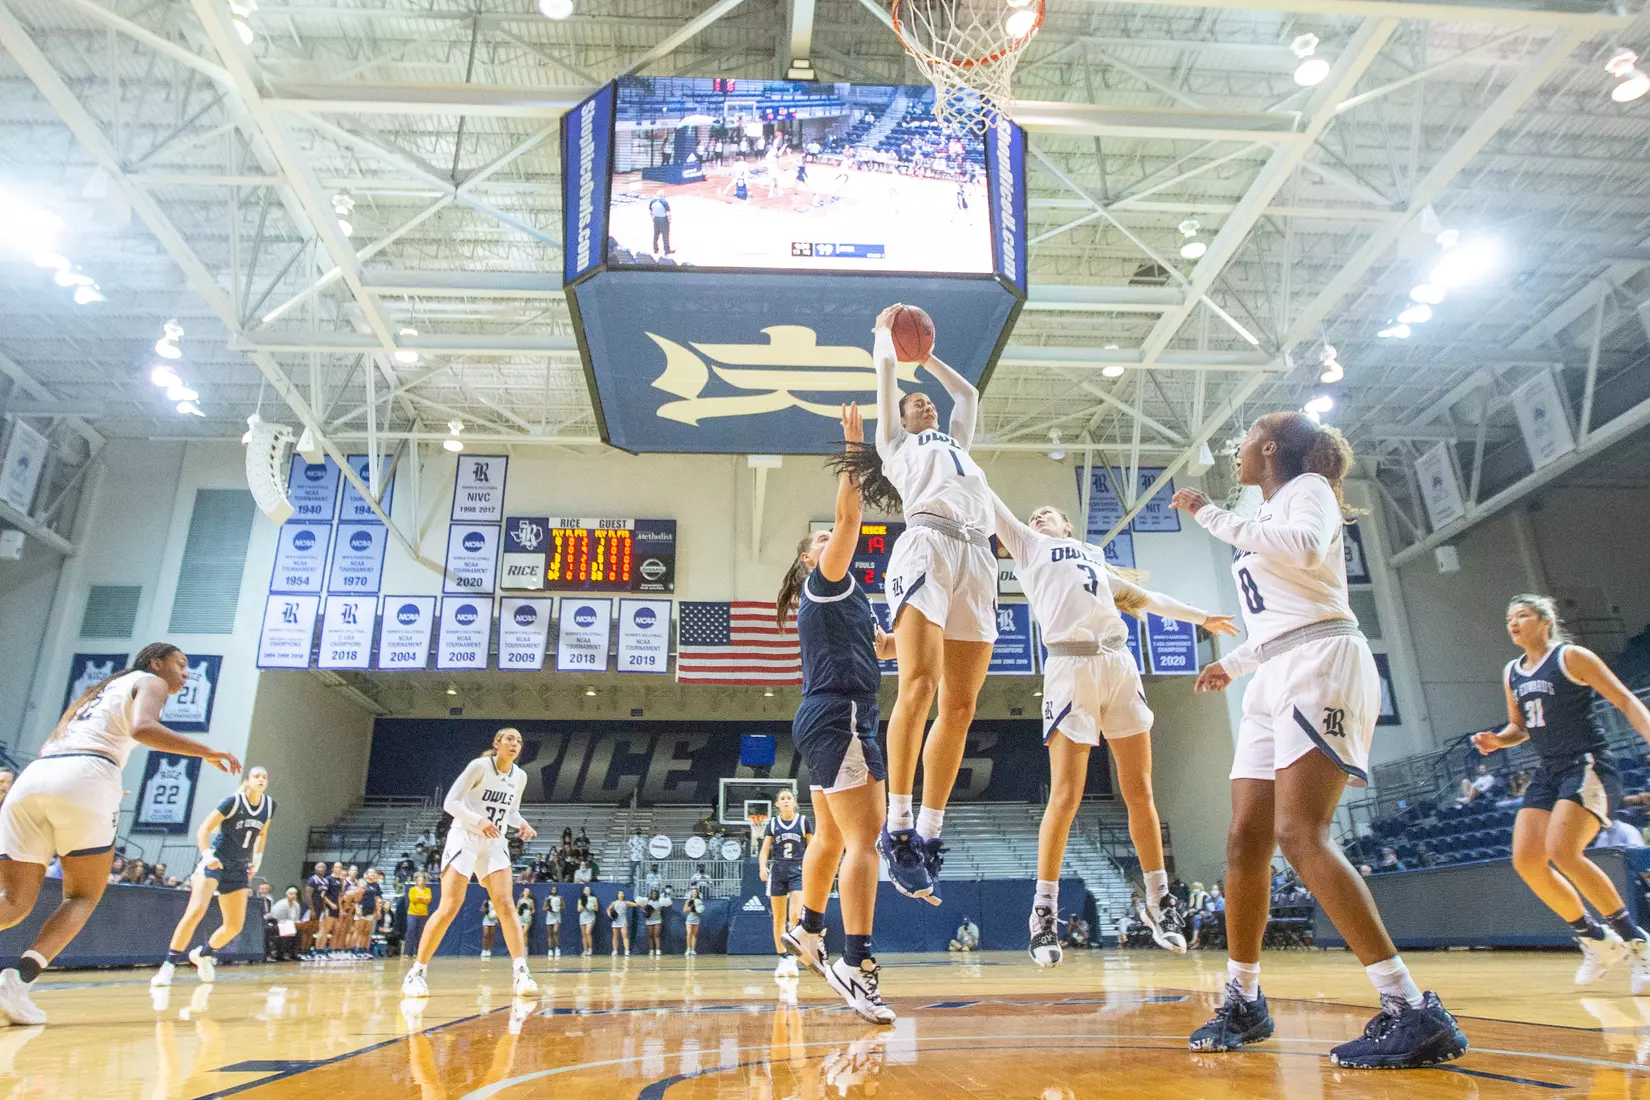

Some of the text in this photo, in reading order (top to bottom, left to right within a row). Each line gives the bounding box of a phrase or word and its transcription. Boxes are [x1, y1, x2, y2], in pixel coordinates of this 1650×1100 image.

[576, 99, 596, 273] ShopRiceOwls.com
[996, 118, 1016, 281] ShopRiceU.com
[917, 432, 961, 450] OWL
[948, 448, 966, 477] 1
[467, 492, 490, 502] NIVC
[298, 505, 322, 514] 1940
[1146, 504, 1161, 513] NIT
[560, 519, 581, 528] RICE
[599, 519, 628, 529] GUEST
[861, 525, 887, 535] RICE
[635, 532, 673, 540] Methodist
[508, 564, 540, 576] RICE
[285, 576, 310, 586] 1954
[343, 576, 368, 586] 1970
[456, 577, 483, 587] 2020
[864, 569, 875, 584] 2
[1076, 564, 1098, 597] 3
[1238, 567, 1266, 614] 0
[332, 651, 358, 661] 2018
[390, 652, 417, 661] 2004
[449, 652, 476, 661] 2008
[508, 653, 535, 663] 2009
[569, 653, 596, 664] 2018
[629, 655, 656, 665] 2019
[1160, 655, 1186, 666] 2020
[177, 686, 197, 704] 21
[1524, 698, 1546, 728] 31
[1323, 707, 1346, 738] R
[160, 770, 182, 780] RICE
[152, 785, 180, 804] 22
[482, 789, 514, 806] OWLS
[242, 830, 253, 849] 1
[783, 843, 793, 859] 2
